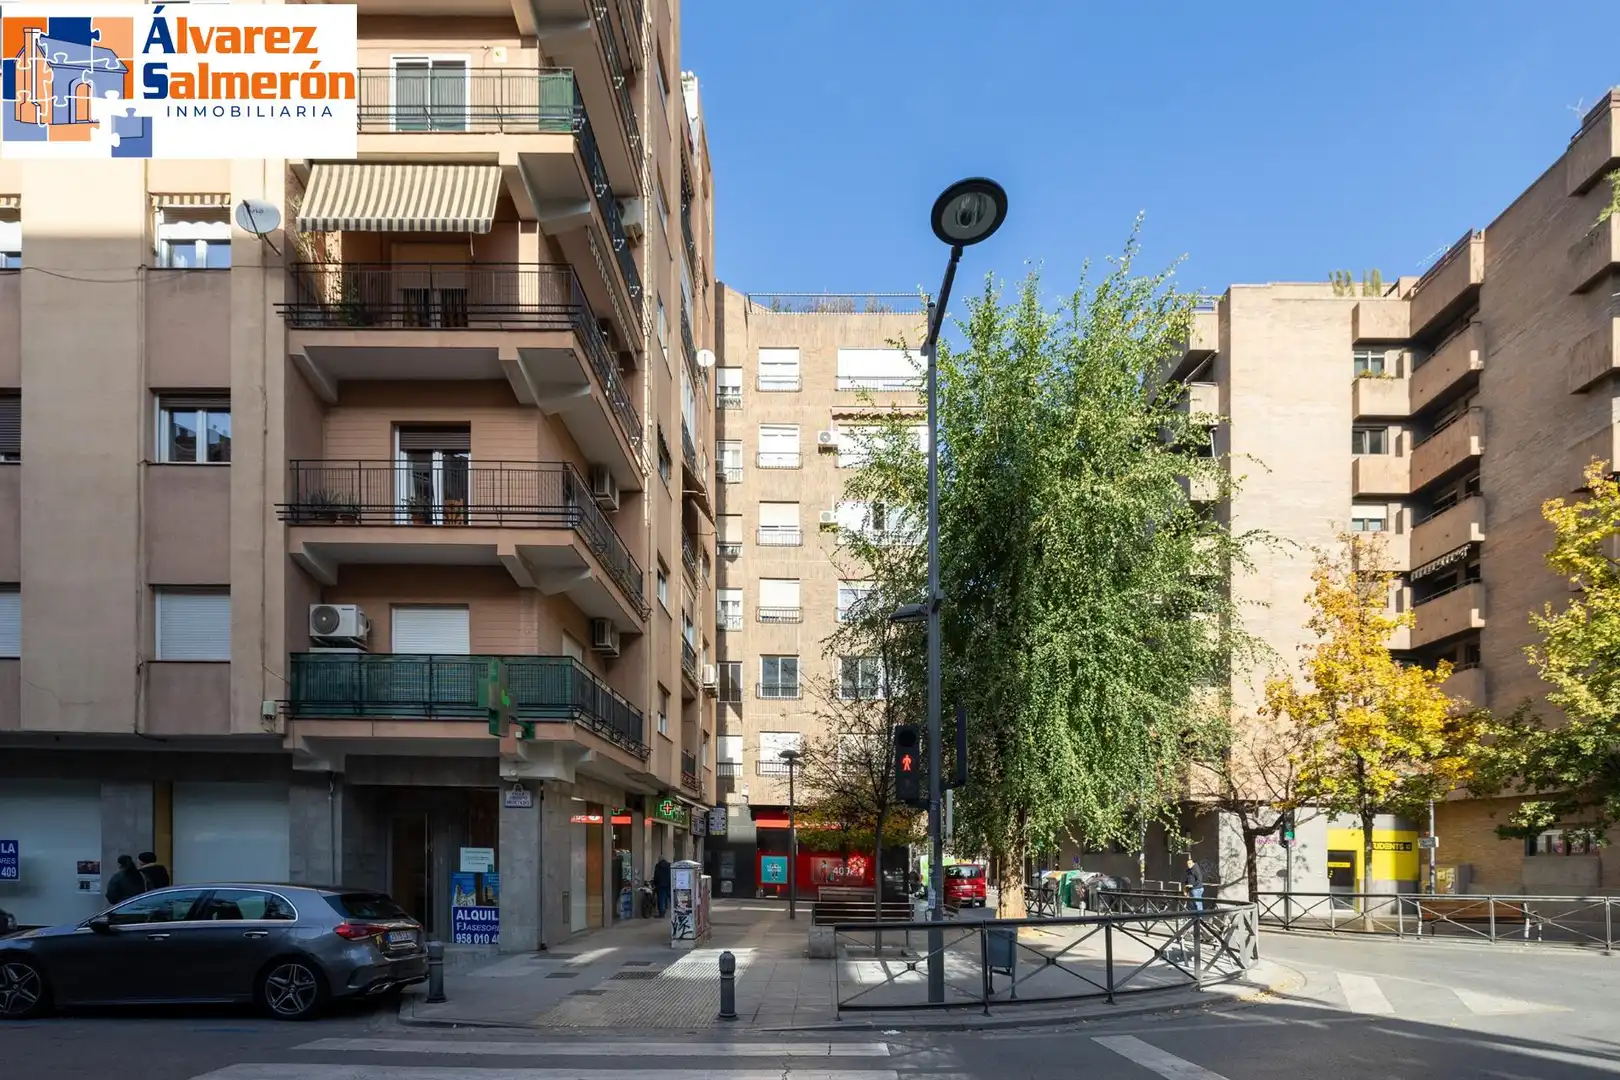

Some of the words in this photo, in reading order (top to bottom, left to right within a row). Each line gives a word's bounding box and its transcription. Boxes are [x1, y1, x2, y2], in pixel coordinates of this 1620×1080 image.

[1373, 842, 1404, 850] UDENTS
[1, 866, 17, 878] 409
[456, 909, 499, 922] ALQUIL
[456, 932, 472, 945] 958
[473, 933, 490, 945] 010
